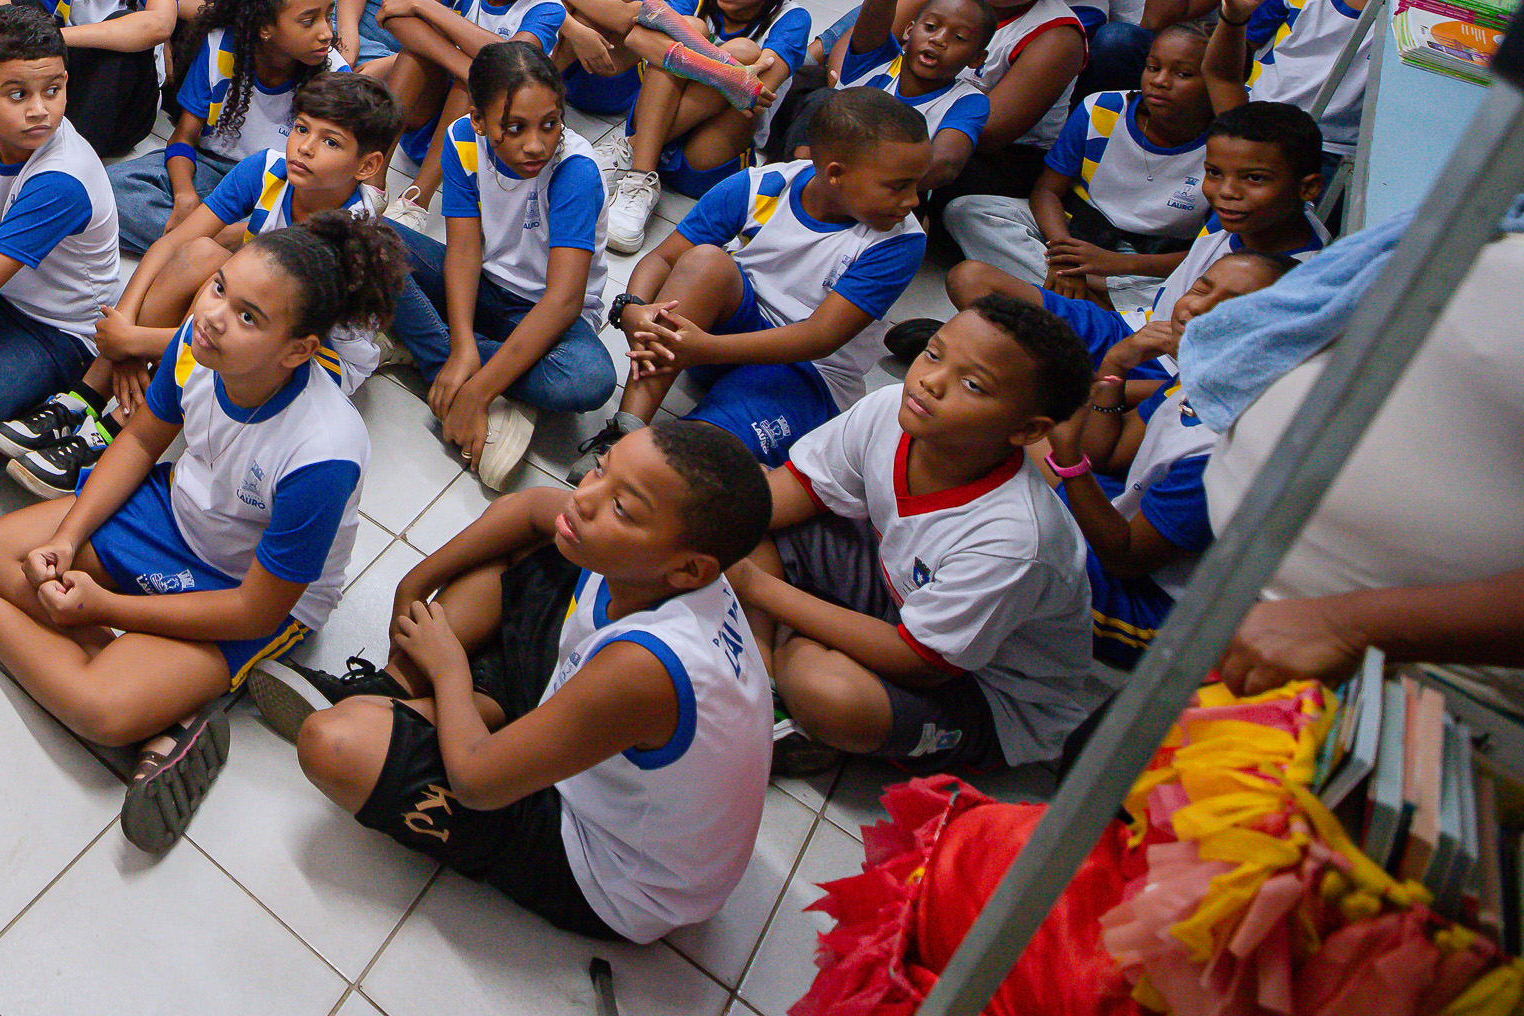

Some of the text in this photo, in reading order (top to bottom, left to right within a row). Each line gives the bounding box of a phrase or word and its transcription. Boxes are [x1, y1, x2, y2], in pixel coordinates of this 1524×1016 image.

[1167, 200, 1195, 211] LAURO
[751, 422, 768, 455] LAURO
[237, 489, 266, 510] LAURO
